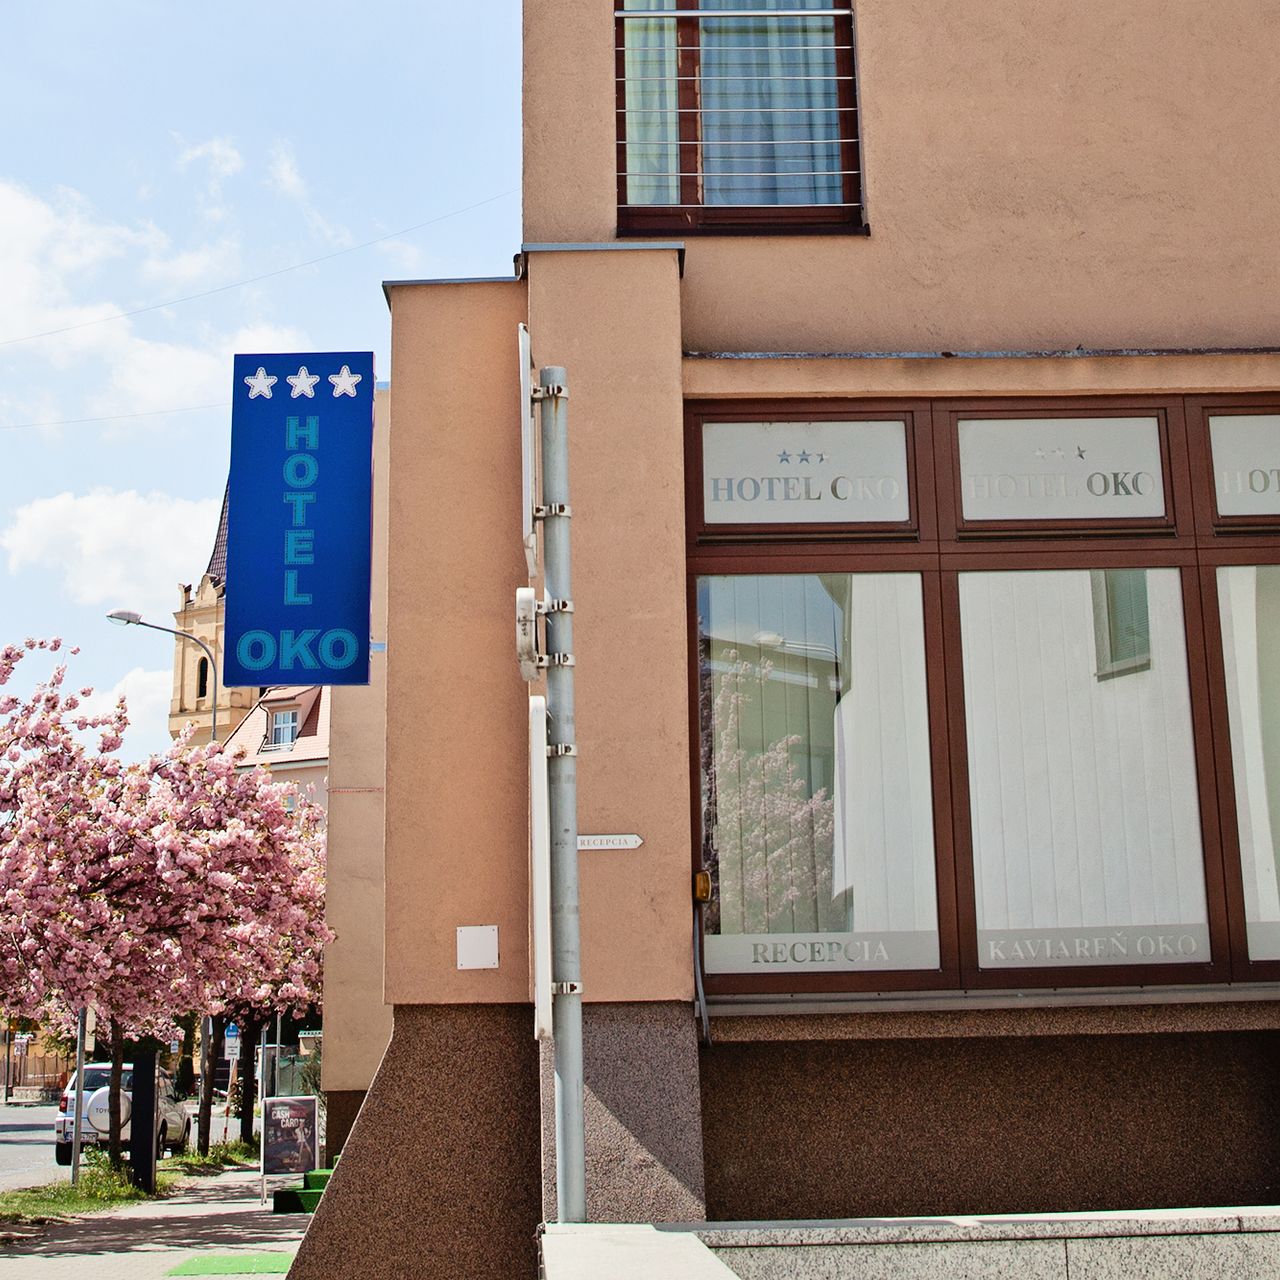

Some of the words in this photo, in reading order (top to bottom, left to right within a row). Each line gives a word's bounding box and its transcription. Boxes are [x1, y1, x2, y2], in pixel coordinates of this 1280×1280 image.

[711, 477, 822, 502] HOTEL
[830, 476, 900, 501] OKO
[1086, 471, 1155, 497] OKO
[283, 415, 320, 605] HOTEL
[237, 628, 359, 671] OKO
[751, 940, 889, 964] RECEPCIA
[988, 930, 1128, 961] KAVIAREŇ
[1136, 934, 1197, 957] OKO
